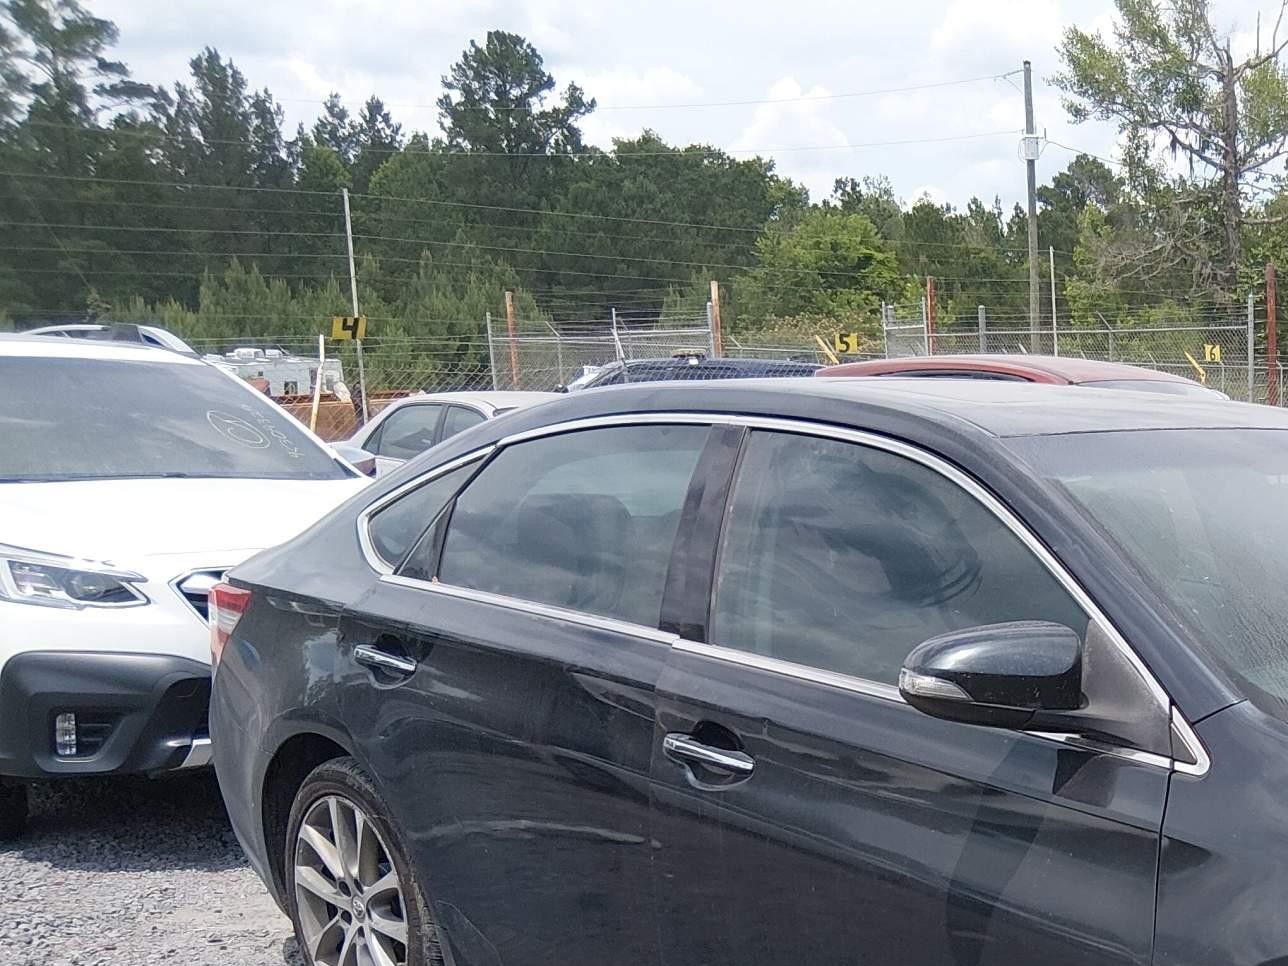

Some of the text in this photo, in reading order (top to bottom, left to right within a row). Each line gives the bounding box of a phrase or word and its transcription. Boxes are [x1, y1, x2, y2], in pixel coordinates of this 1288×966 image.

[342, 317, 360, 340] 4
[838, 333, 851, 353] 5
[1209, 345, 1217, 362] 6
